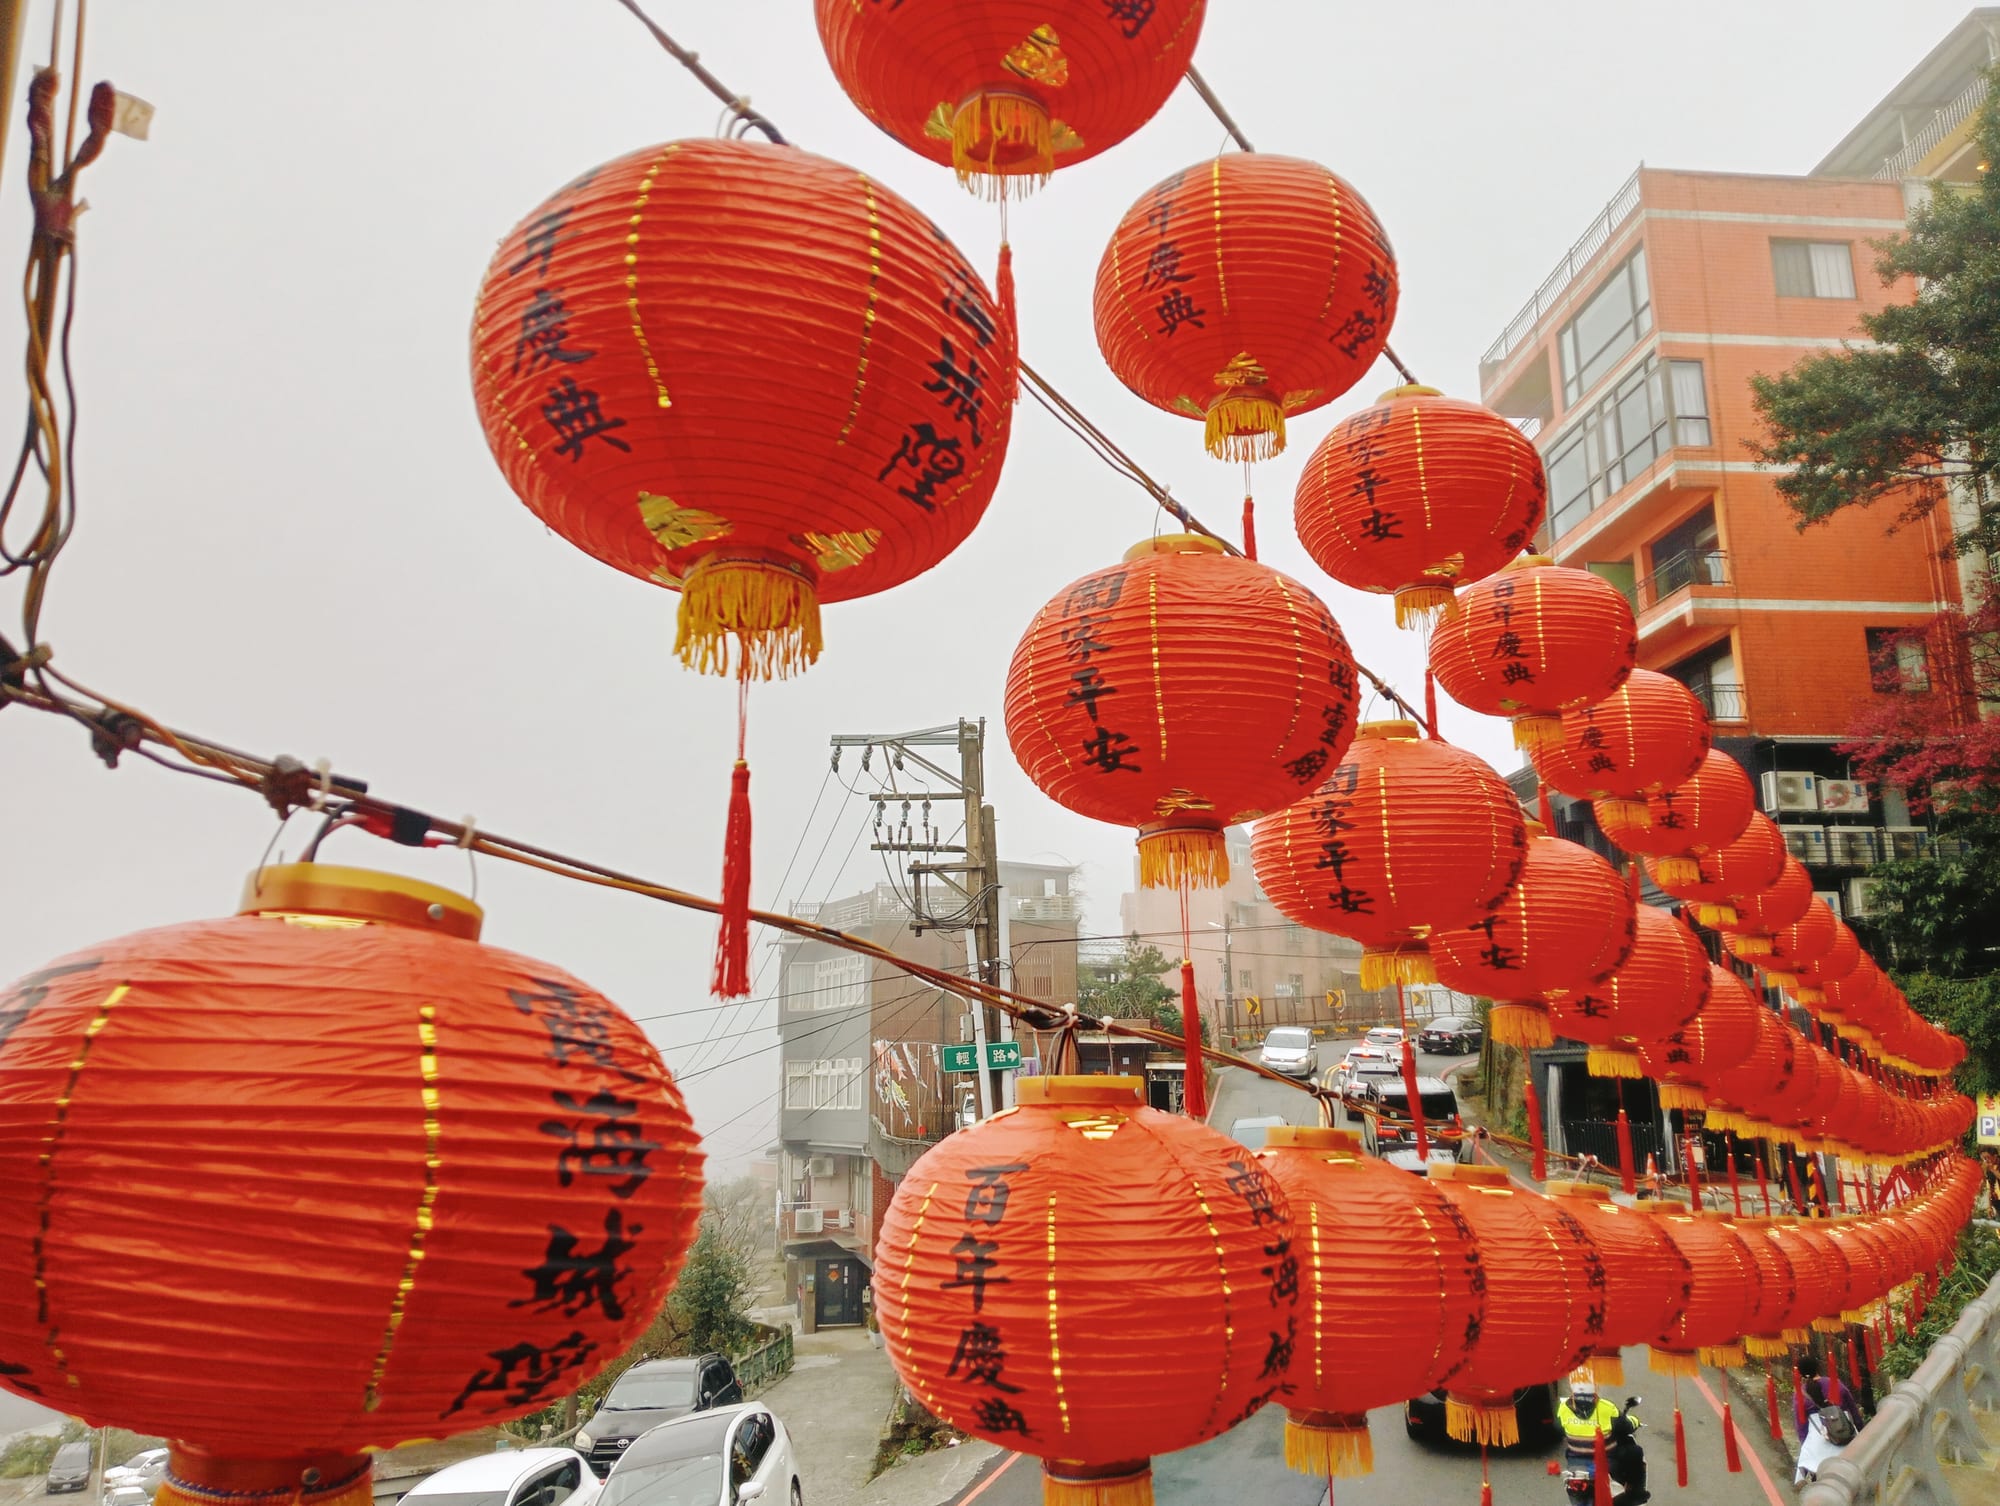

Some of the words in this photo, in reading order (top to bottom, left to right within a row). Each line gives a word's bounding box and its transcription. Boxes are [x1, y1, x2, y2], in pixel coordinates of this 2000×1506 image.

[508, 172, 632, 462] 年慶典
[1061, 571, 1141, 774] 闔家平安
[956, 1049, 1006, 1065] 輕路
[939, 1162, 1045, 1443] 百年慶典
